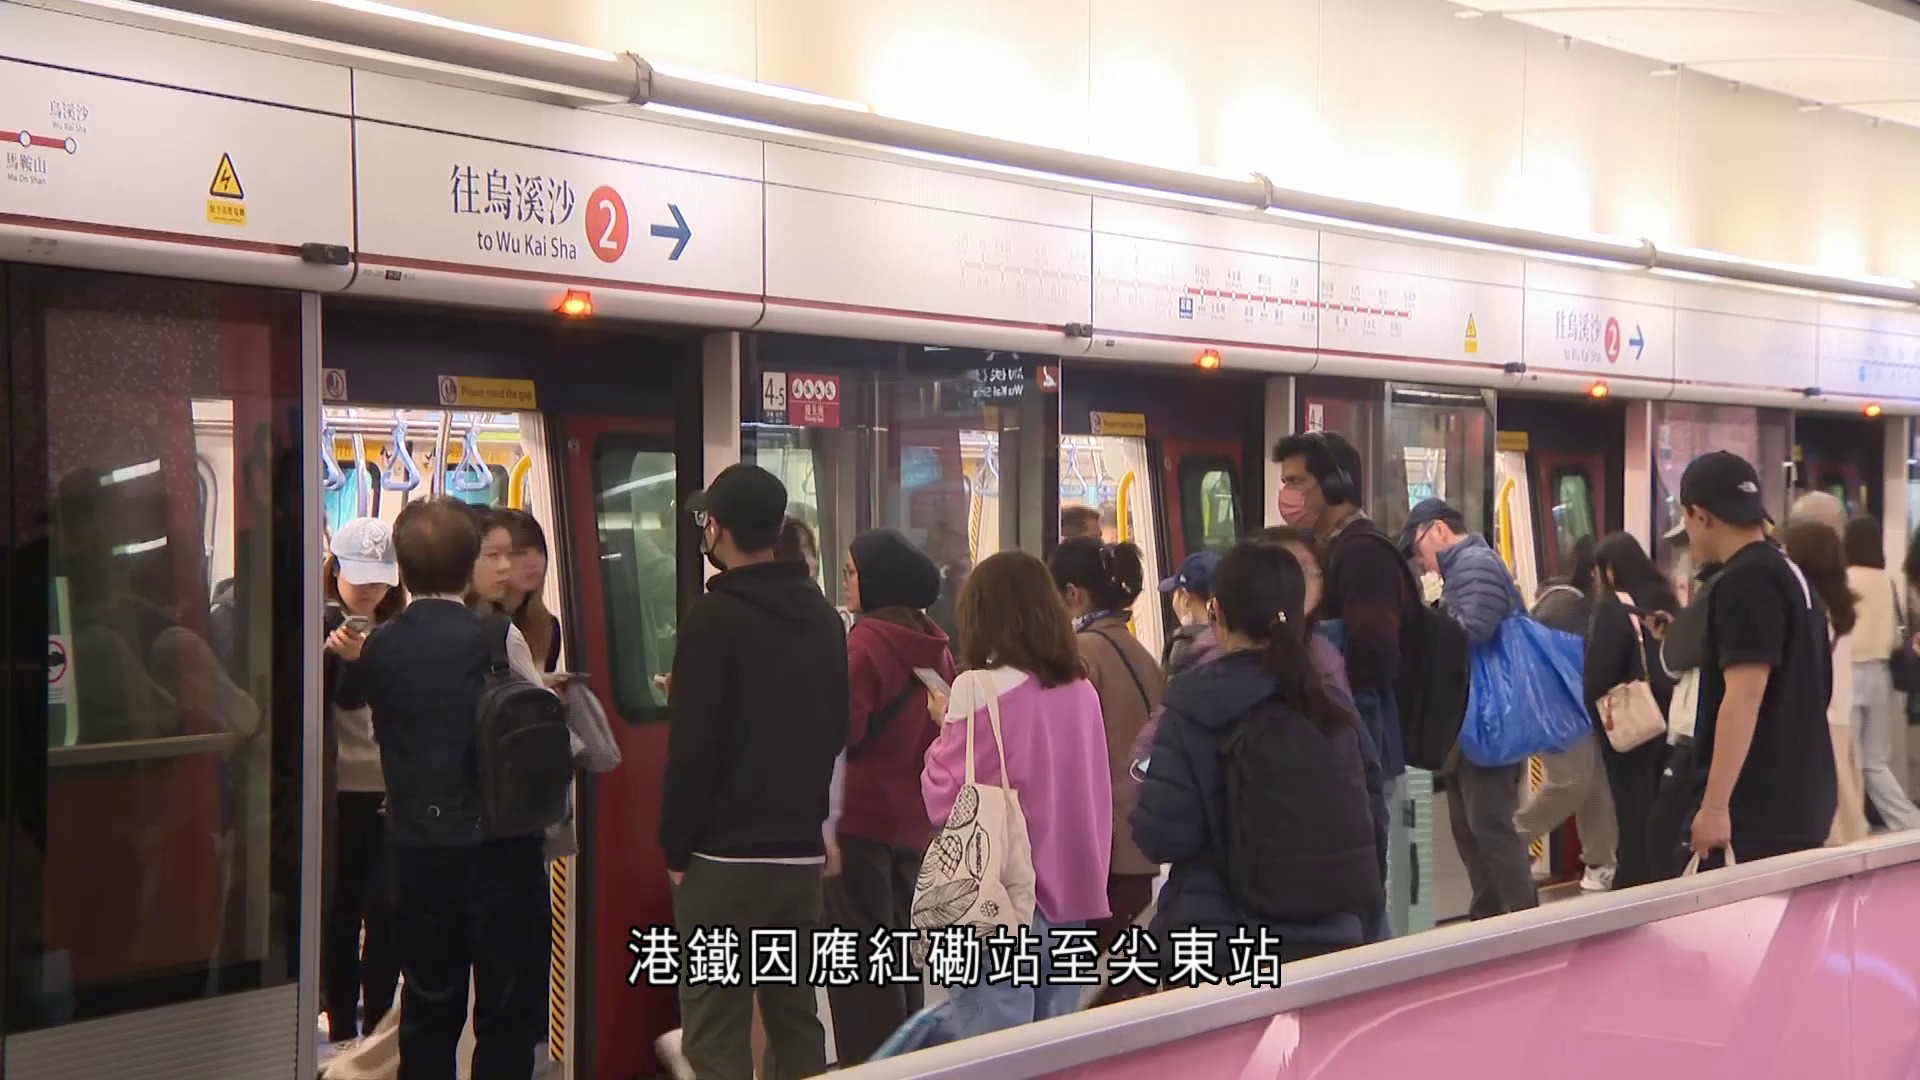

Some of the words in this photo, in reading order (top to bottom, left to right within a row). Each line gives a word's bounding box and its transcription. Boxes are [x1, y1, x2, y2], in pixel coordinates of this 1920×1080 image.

[450, 164, 575, 225] 往烏溪沙
[599, 197, 618, 250] 2
[477, 231, 493, 251] to
[496, 230, 521, 254] Wu
[524, 233, 547, 257] Kai
[551, 236, 577, 260] Sha
[1608, 322, 1618, 356] 2
[765, 377, 785, 407] 4-5
